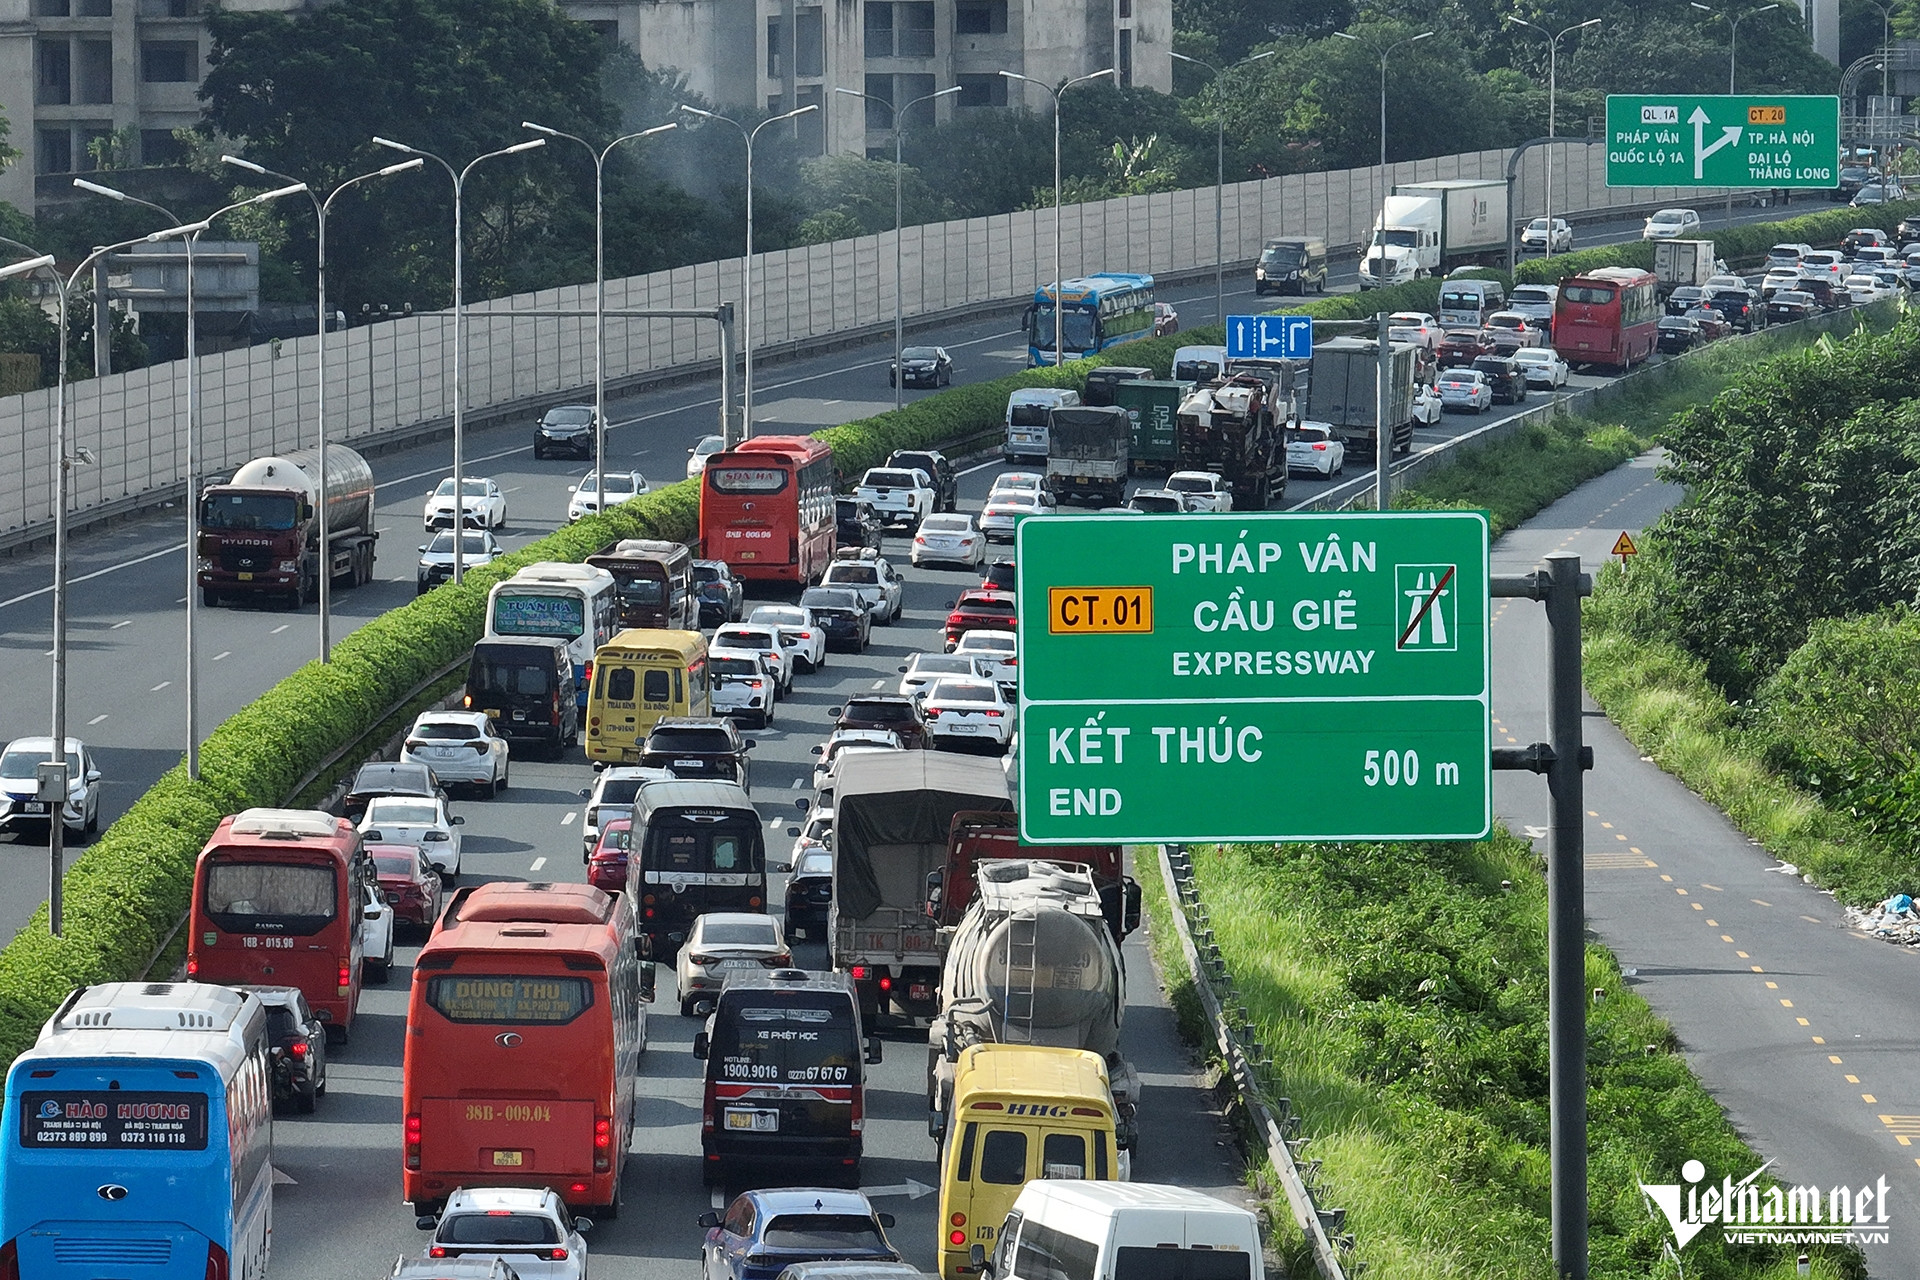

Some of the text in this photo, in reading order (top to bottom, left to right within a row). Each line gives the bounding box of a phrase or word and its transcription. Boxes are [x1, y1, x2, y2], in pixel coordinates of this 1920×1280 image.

[1643, 109, 1676, 121] QL.1A
[1750, 109, 1784, 121] CT.20
[1616, 129, 1679, 144] PHÁP VÂN
[1749, 130, 1815, 147] TP.HÀ NỘI
[1610, 147, 1685, 166] QUỐC LỘ 1A
[1749, 149, 1791, 167] ĐẠI LỘ
[1796, 167, 1830, 180] LONG
[222, 538, 272, 546] HYUNDAI
[1172, 530, 1376, 574] PHÁP VÂN
[1060, 594, 1142, 627] CT.01
[1193, 585, 1358, 632] CẦU GIẼ
[1173, 650, 1375, 676] EXPRESSWAY
[1049, 711, 1264, 764] KẾT THÚC
[1364, 749, 1460, 786] 500 m
[1049, 787, 1123, 816] END
[869, 934, 884, 949] TK
[757, 1031, 769, 1039] XE
[723, 1064, 778, 1079] 1900.9016
[820, 1067, 834, 1080] 67
[834, 1067, 848, 1081] 67
[66, 1100, 190, 1119] HÀO HƯƠNG
[466, 1105, 493, 1121] 38B
[505, 1105, 551, 1122] 009.04
[1007, 1103, 1068, 1118] HHG
[37, 1131, 67, 1142] 02373
[120, 1133, 145, 1143] 0373
[168, 1133, 186, 1144] 118
[975, 1225, 994, 1239] 17B
